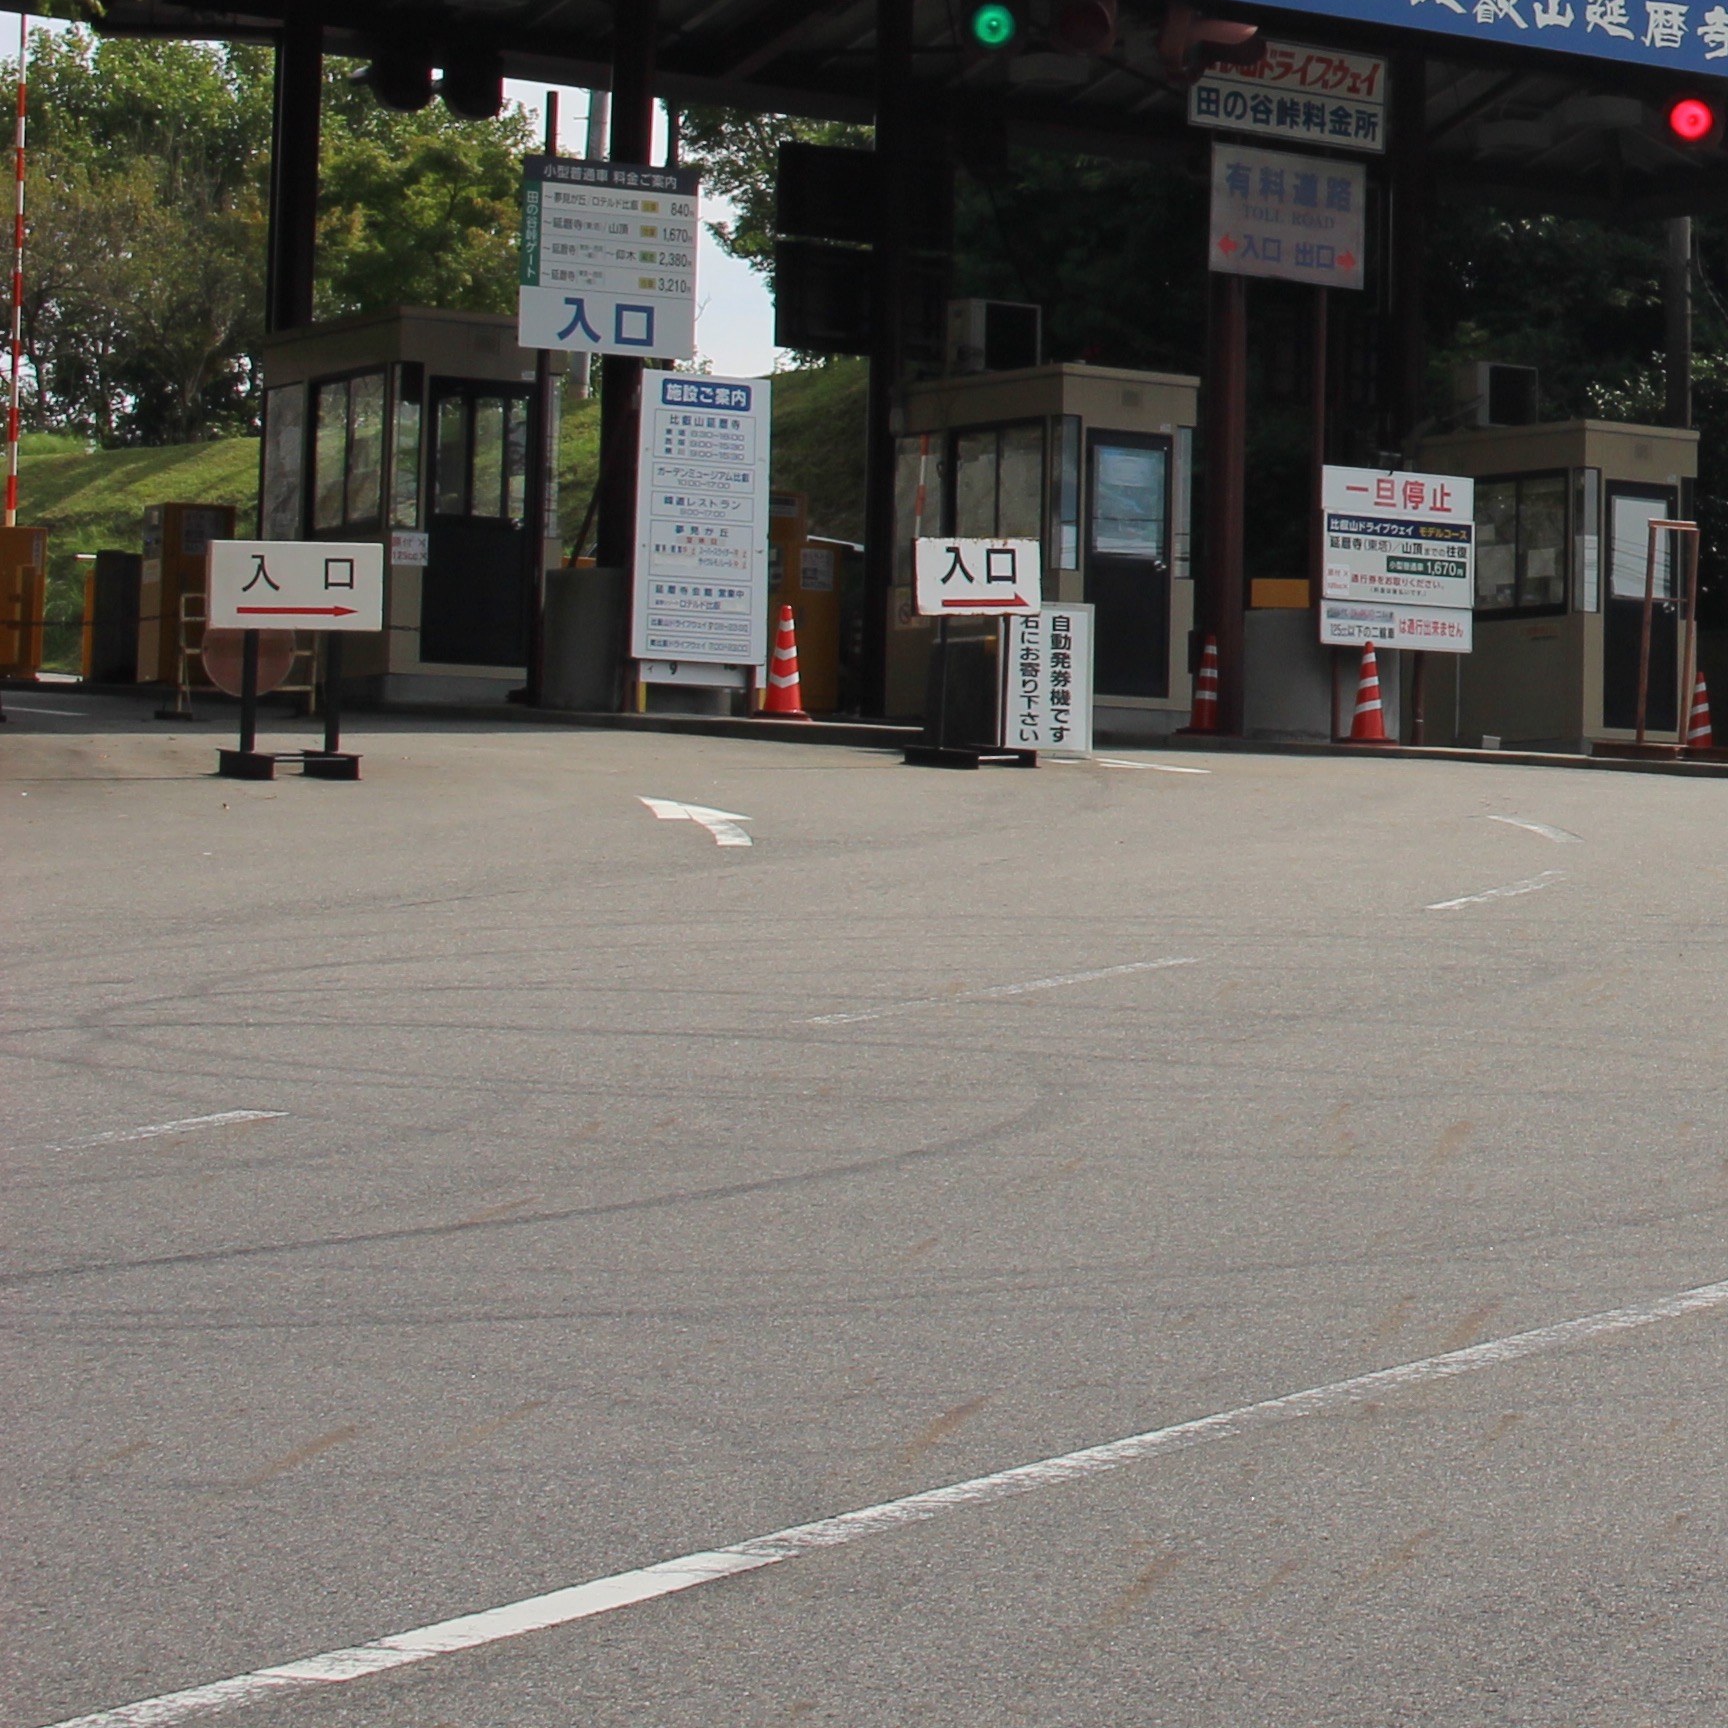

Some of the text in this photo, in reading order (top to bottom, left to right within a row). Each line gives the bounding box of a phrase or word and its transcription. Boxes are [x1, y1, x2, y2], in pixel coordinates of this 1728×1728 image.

[1206, 49, 1382, 97] ドライブウェイ
[1197, 85, 1379, 142] 田の谷峠料金所
[543, 163, 678, 190] 小型普通車 料金ご案内
[1225, 162, 1353, 212] 有料道路
[1243, 205, 1336, 230] TOLL ROAD
[1241, 234, 1336, 270] 入口 出口
[556, 297, 655, 348] 入口
[666, 382, 747, 408] 施設ご案内
[1346, 478, 1453, 512] 一旦停止
[1330, 518, 1468, 540] 比叡山ドライブウェイ モデルコース
[241, 554, 356, 593] 入口
[941, 546, 1017, 584] 入口
[1019, 616, 1041, 743] 右にお寄り下さい
[1049, 614, 1072, 743] 自動発券機です
